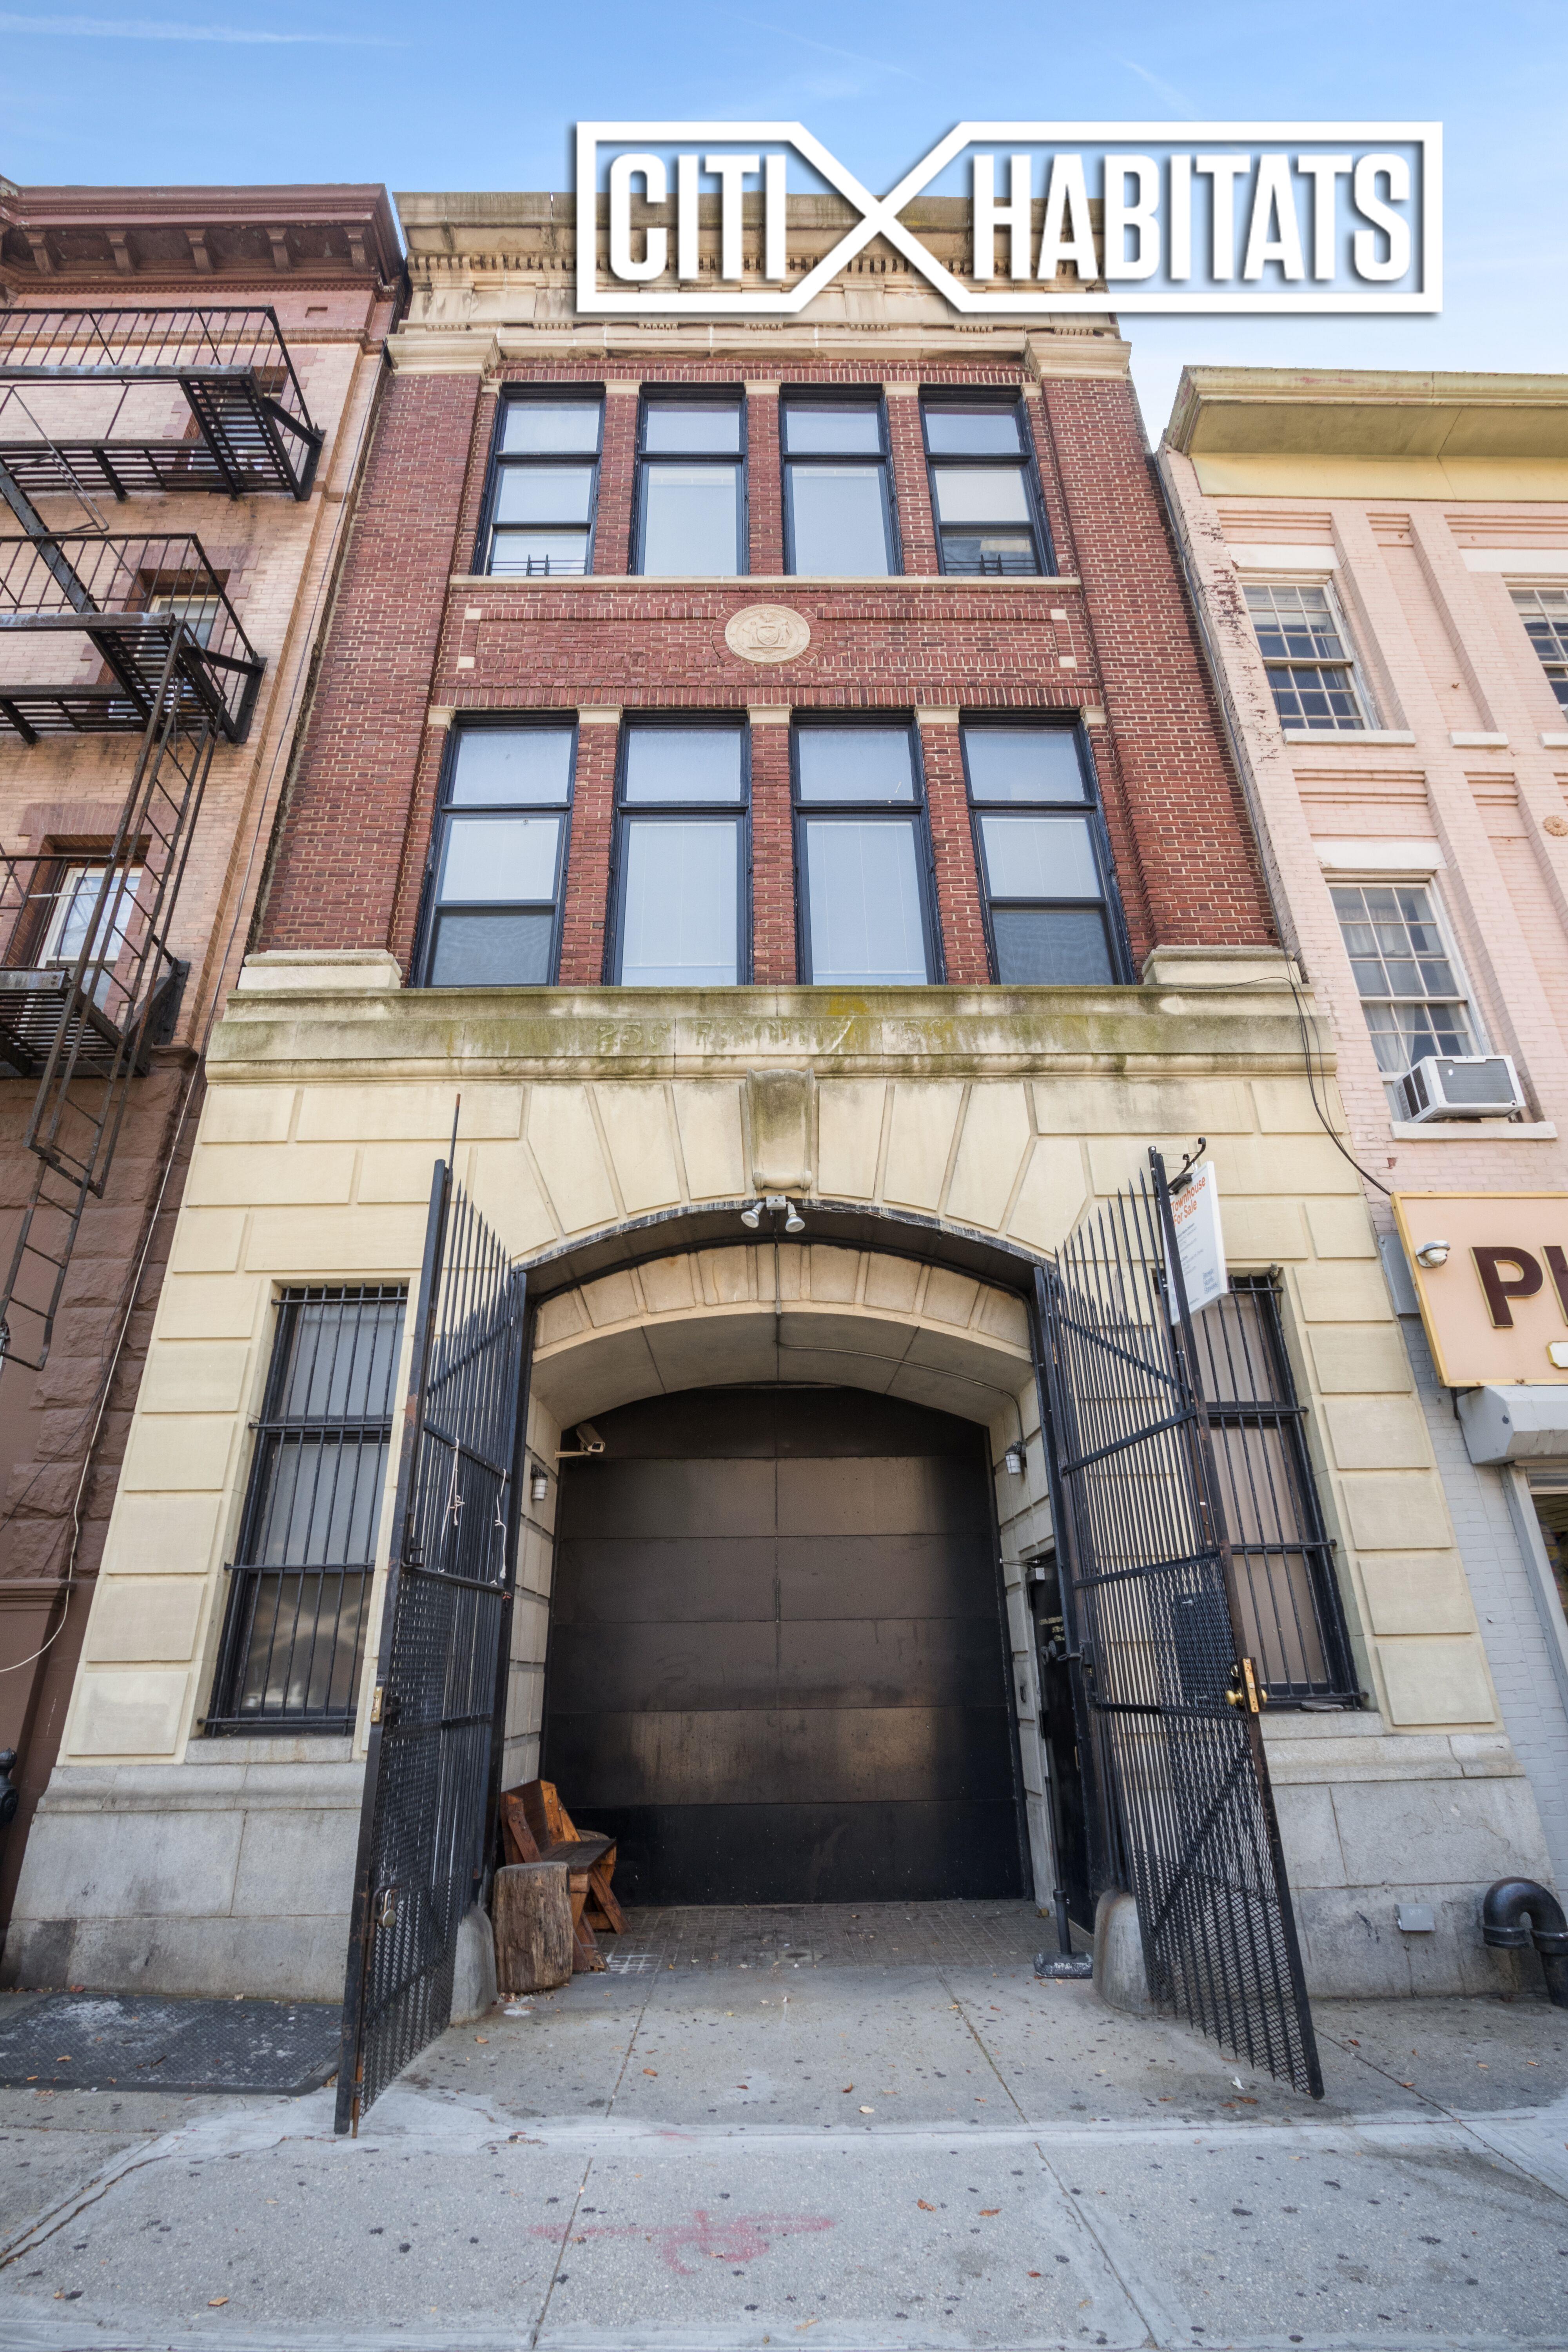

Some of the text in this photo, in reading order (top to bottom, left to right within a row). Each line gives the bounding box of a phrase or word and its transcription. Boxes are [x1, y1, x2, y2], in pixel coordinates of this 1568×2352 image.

[734, 607, 801, 625] FIRE DEPARTMENT
[732, 644, 750, 656] CITY
[785, 644, 802, 656] YORK
[1171, 1176, 1205, 1214] Townhouse
[1173, 1200, 1197, 1228] For Sale
